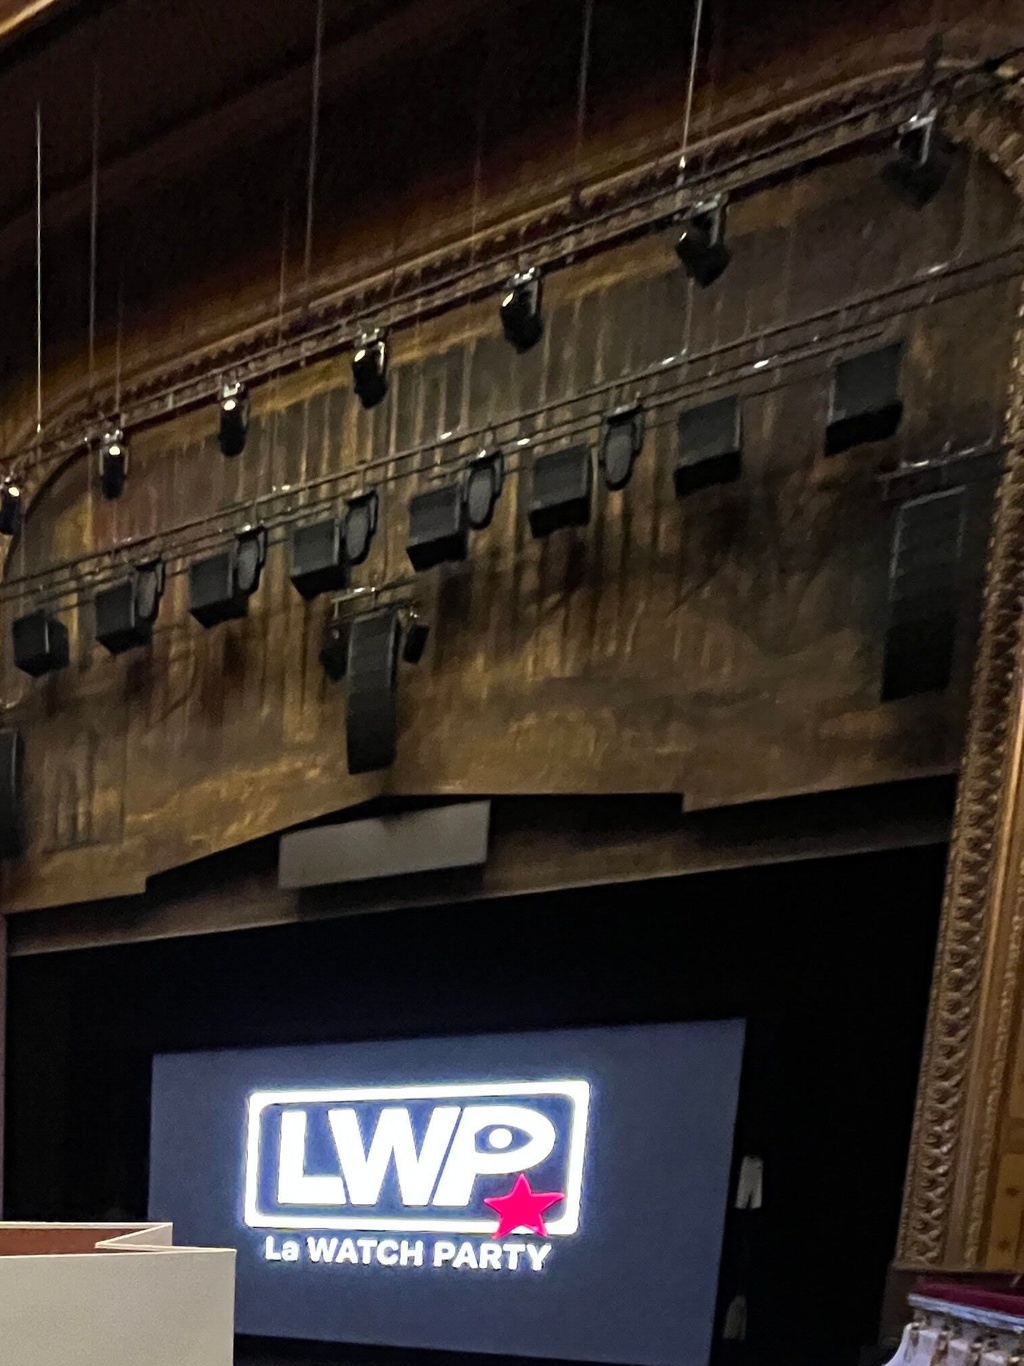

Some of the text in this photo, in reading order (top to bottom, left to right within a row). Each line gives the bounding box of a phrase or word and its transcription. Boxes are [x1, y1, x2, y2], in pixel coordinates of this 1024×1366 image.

[277, 1105, 556, 1206] LWP
[265, 1236, 551, 1271] La WATCH PARTY
